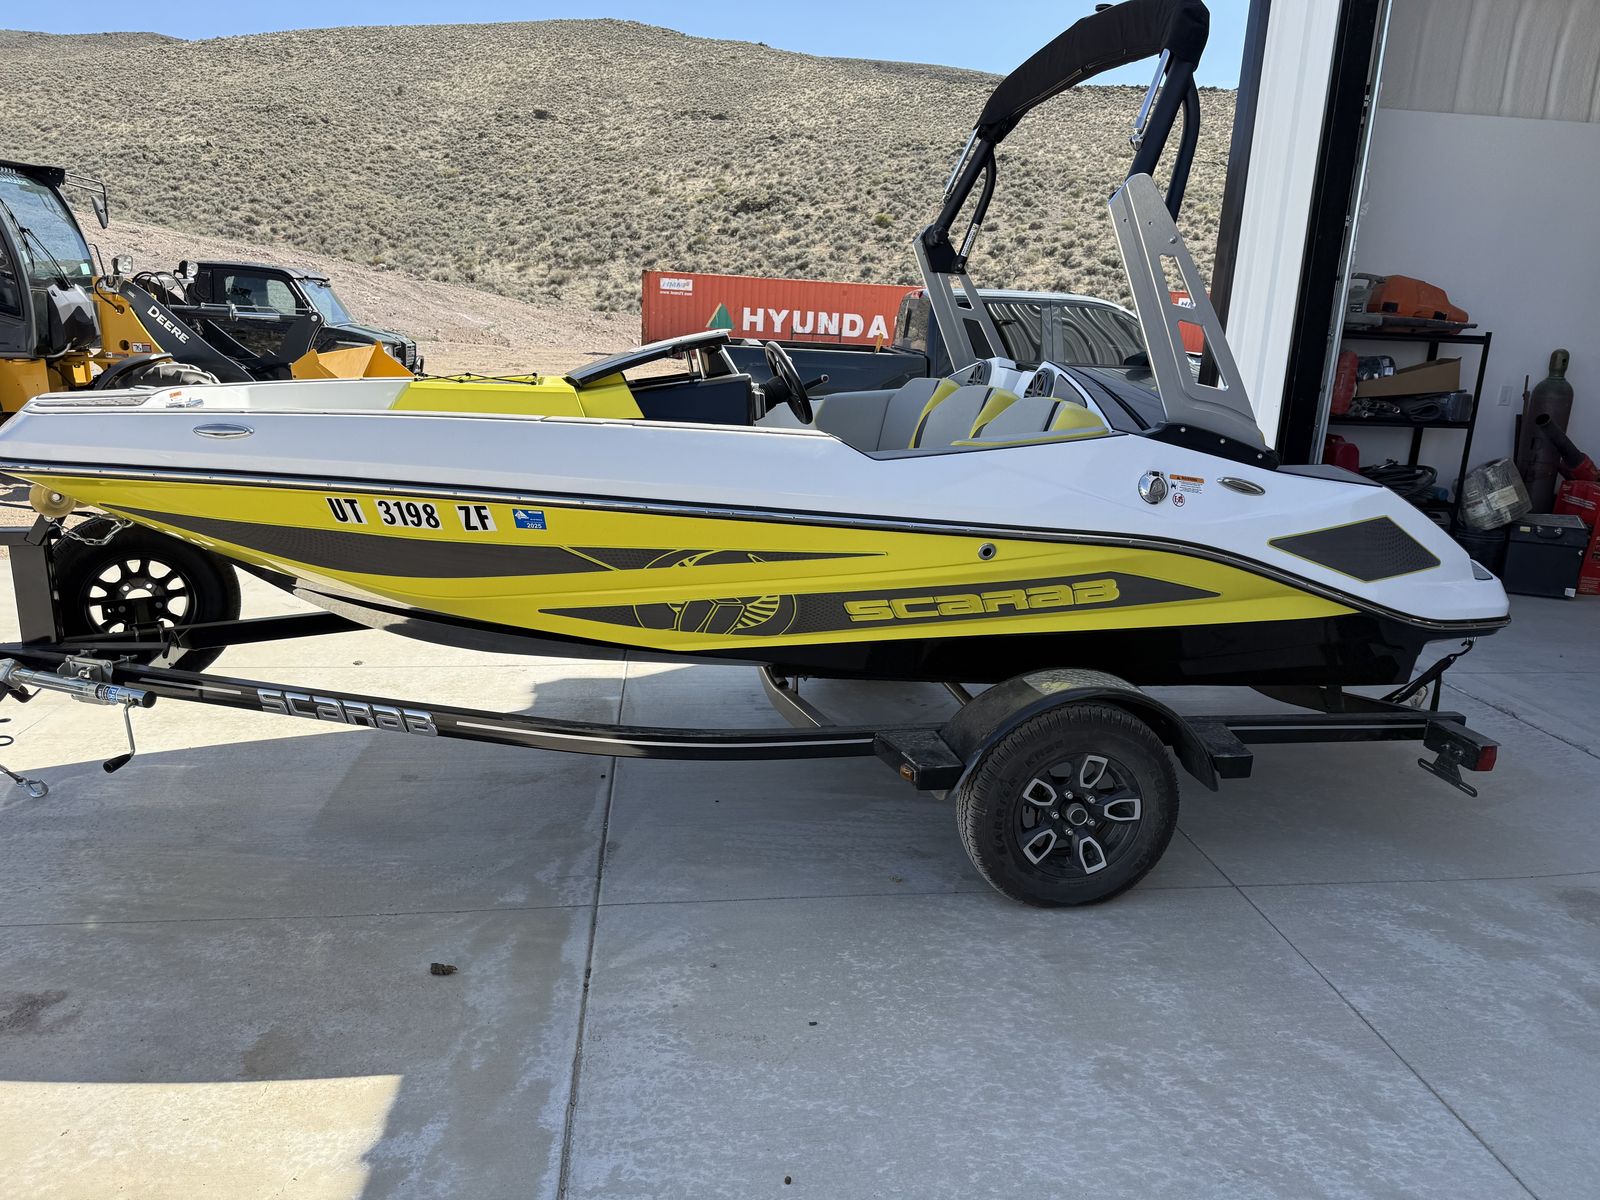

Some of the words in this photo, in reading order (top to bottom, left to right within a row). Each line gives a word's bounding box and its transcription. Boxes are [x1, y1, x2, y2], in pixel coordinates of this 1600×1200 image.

[147, 305, 190, 344] DEERE
[742, 307, 897, 340] HYUNDA
[326, 497, 362, 523] UT
[377, 500, 440, 527] 3198
[458, 505, 491, 531] ZF
[843, 578, 1121, 622] SCARAB
[257, 688, 438, 737] SCARAB
